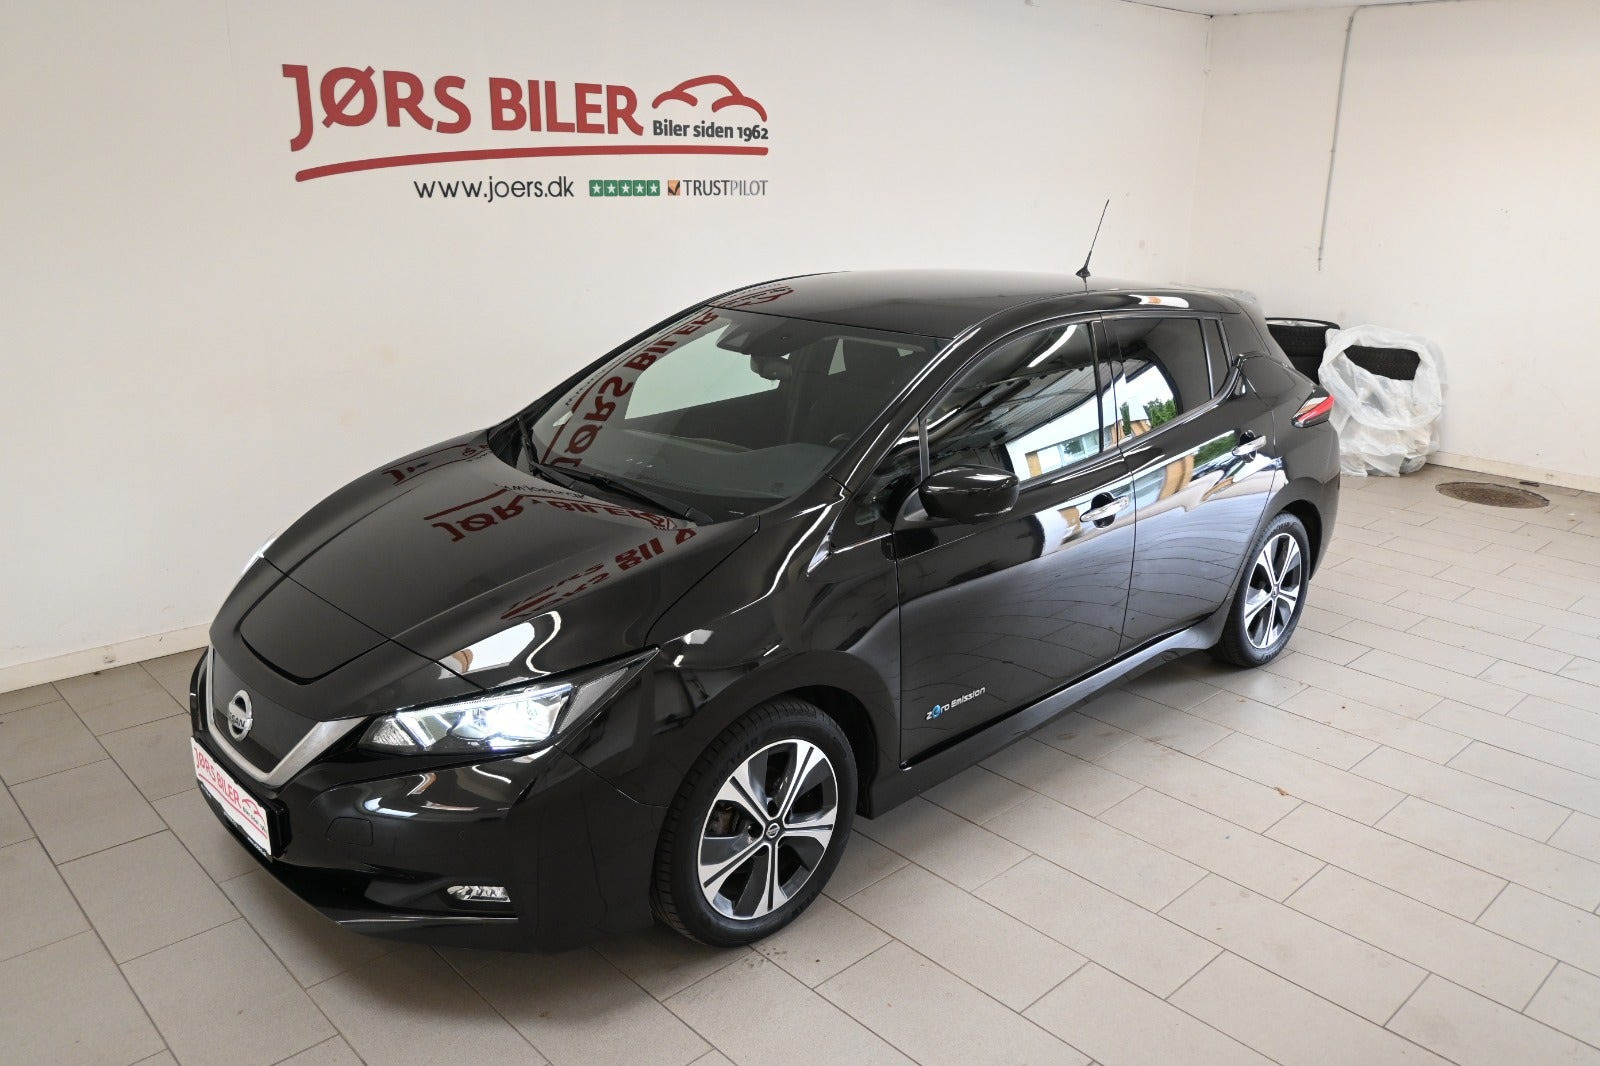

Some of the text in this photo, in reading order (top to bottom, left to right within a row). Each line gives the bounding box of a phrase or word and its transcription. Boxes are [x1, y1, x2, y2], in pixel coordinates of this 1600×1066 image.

[282, 64, 644, 152] JØRS BILER
[653, 119, 768, 142] Biler siden 1962
[414, 175, 574, 203] www.joers.dk
[683, 180, 768, 196] TRUSTPILOT
